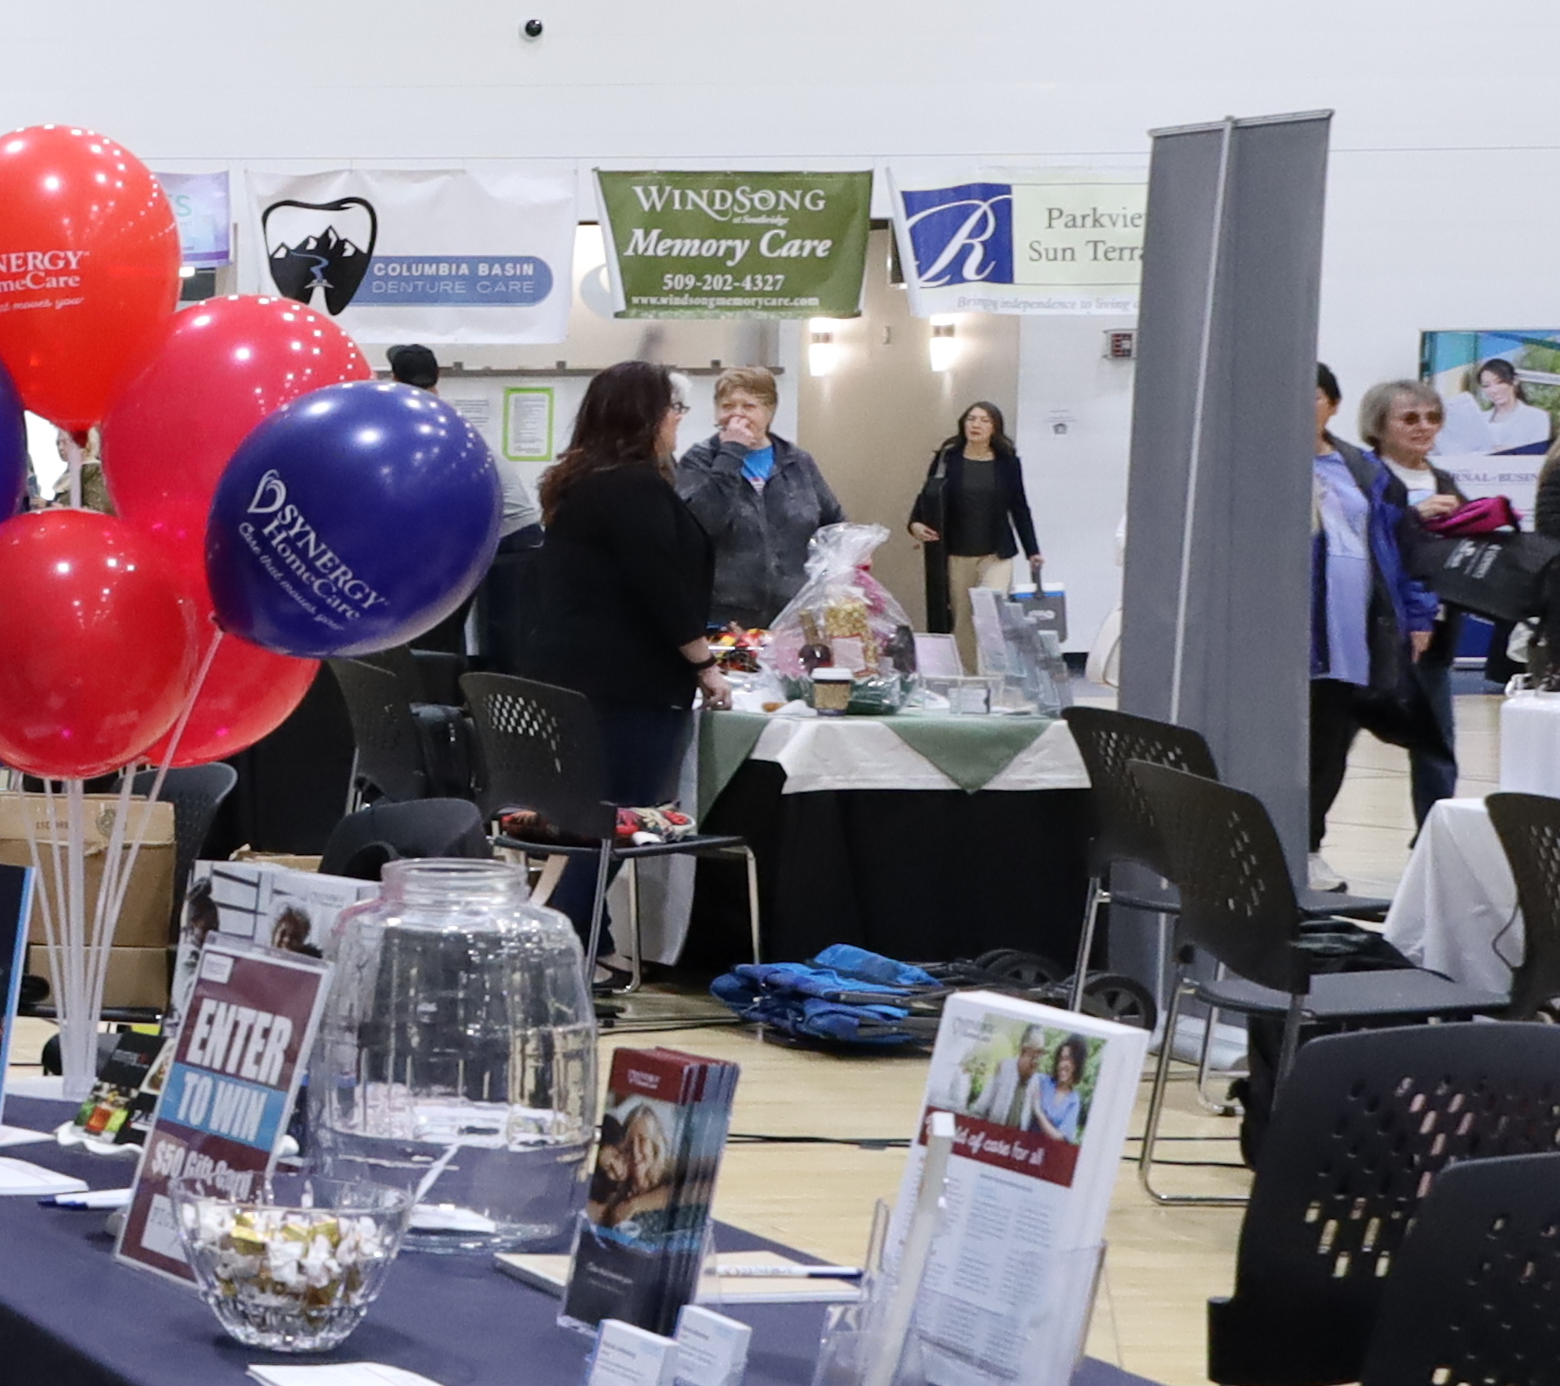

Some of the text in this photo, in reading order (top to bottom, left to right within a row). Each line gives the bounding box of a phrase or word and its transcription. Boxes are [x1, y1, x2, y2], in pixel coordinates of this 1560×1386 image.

[623, 228, 833, 266] Memory Care
[1029, 240, 1076, 262] Sun
[372, 281, 534, 293] DENTURE CARE
[373, 263, 534, 276] COLUMBIA BASIN
[662, 274, 785, 291] 509-202-4327
[1000, 297, 1077, 311] independence
[239, 522, 261, 555] Care
[259, 554, 283, 581] that
[280, 580, 317, 614] moves
[262, 518, 360, 621] HomeCare
[277, 504, 386, 610] SYNERGY
[186, 997, 293, 1086] ENTER
[177, 1071, 268, 1143] TO WIN
[152, 1139, 185, 1179] $50
[182, 1150, 214, 1185] Gift
